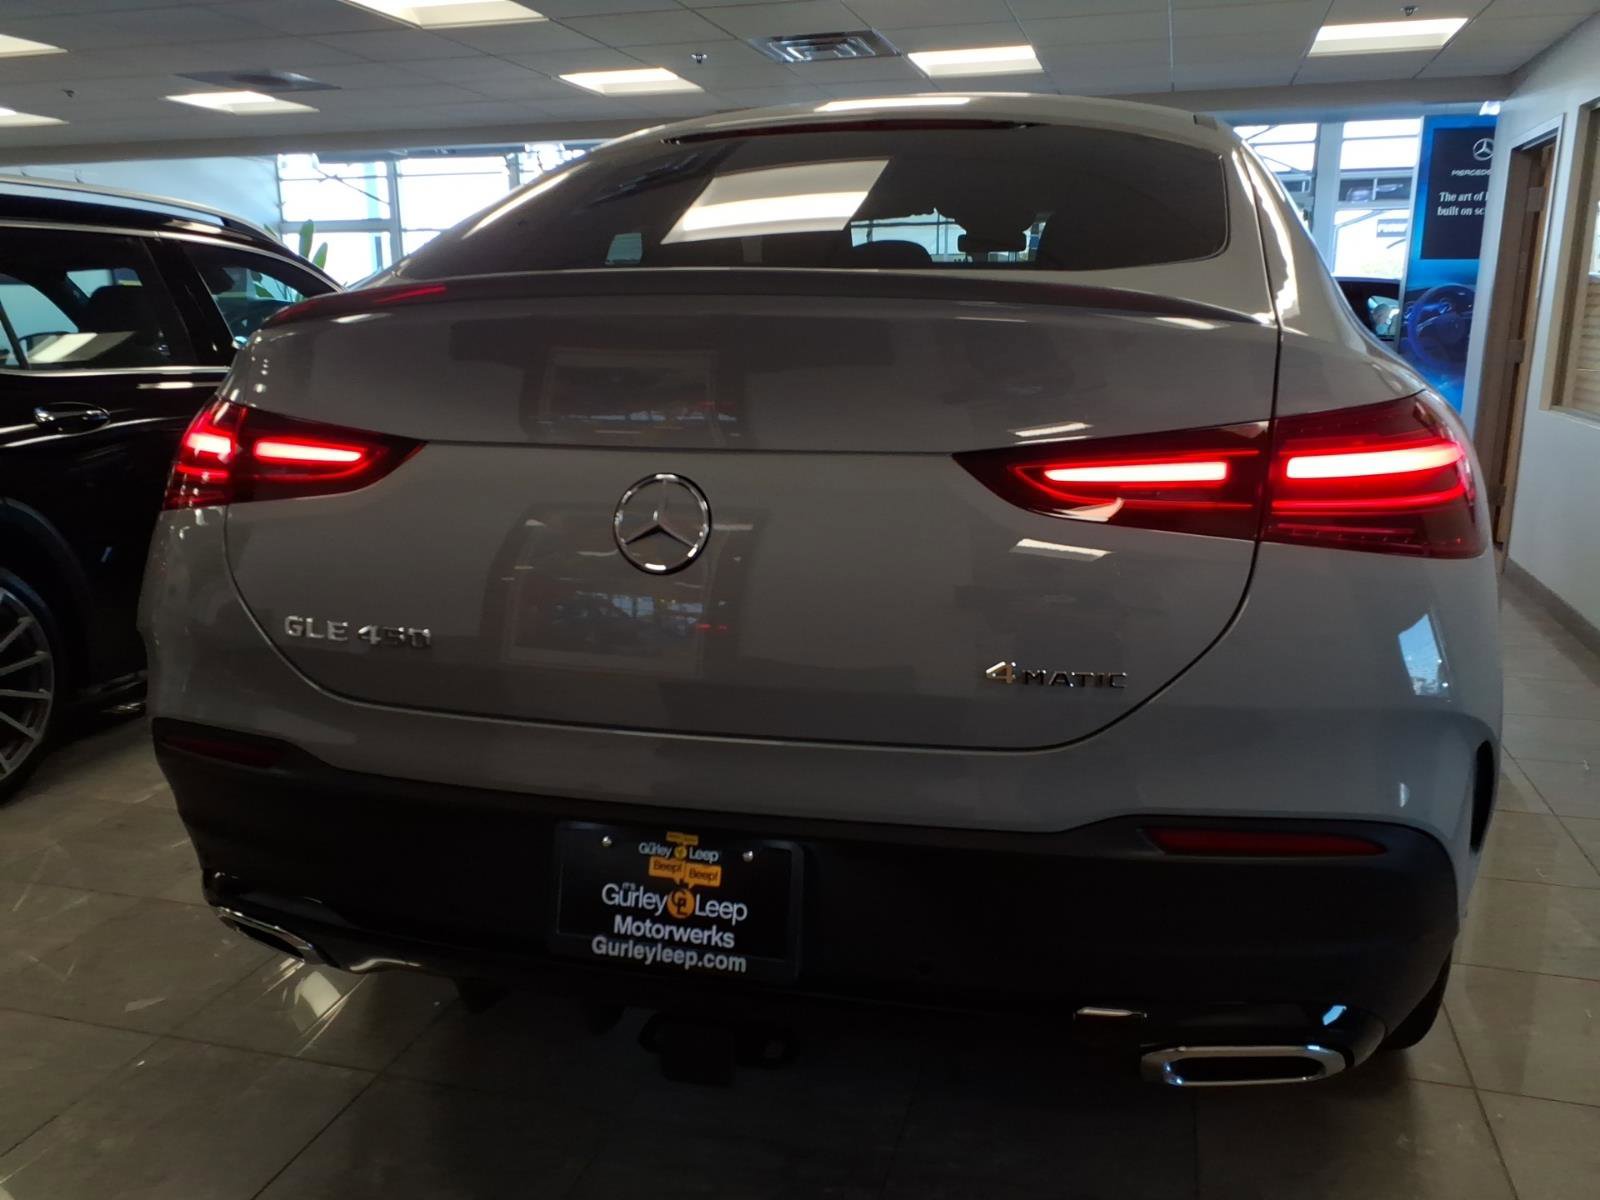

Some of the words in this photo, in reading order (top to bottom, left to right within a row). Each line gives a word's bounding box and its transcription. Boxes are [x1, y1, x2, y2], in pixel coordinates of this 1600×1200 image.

[1437, 205, 1459, 216] built
[1460, 207, 1473, 216] on
[1439, 191, 1457, 202] The
[1458, 193, 1472, 202] art
[1473, 191, 1483, 202] of
[284, 615, 348, 641] GLE
[358, 624, 431, 647] 450
[689, 847, 719, 864] Leep
[653, 859, 682, 875] Beep!
[689, 867, 719, 884] Beep!
[601, 883, 668, 916] Gurley
[695, 893, 748, 926] Leep
[613, 914, 735, 949] Motorwerks
[591, 936, 747, 973] Gurleyleep.com
